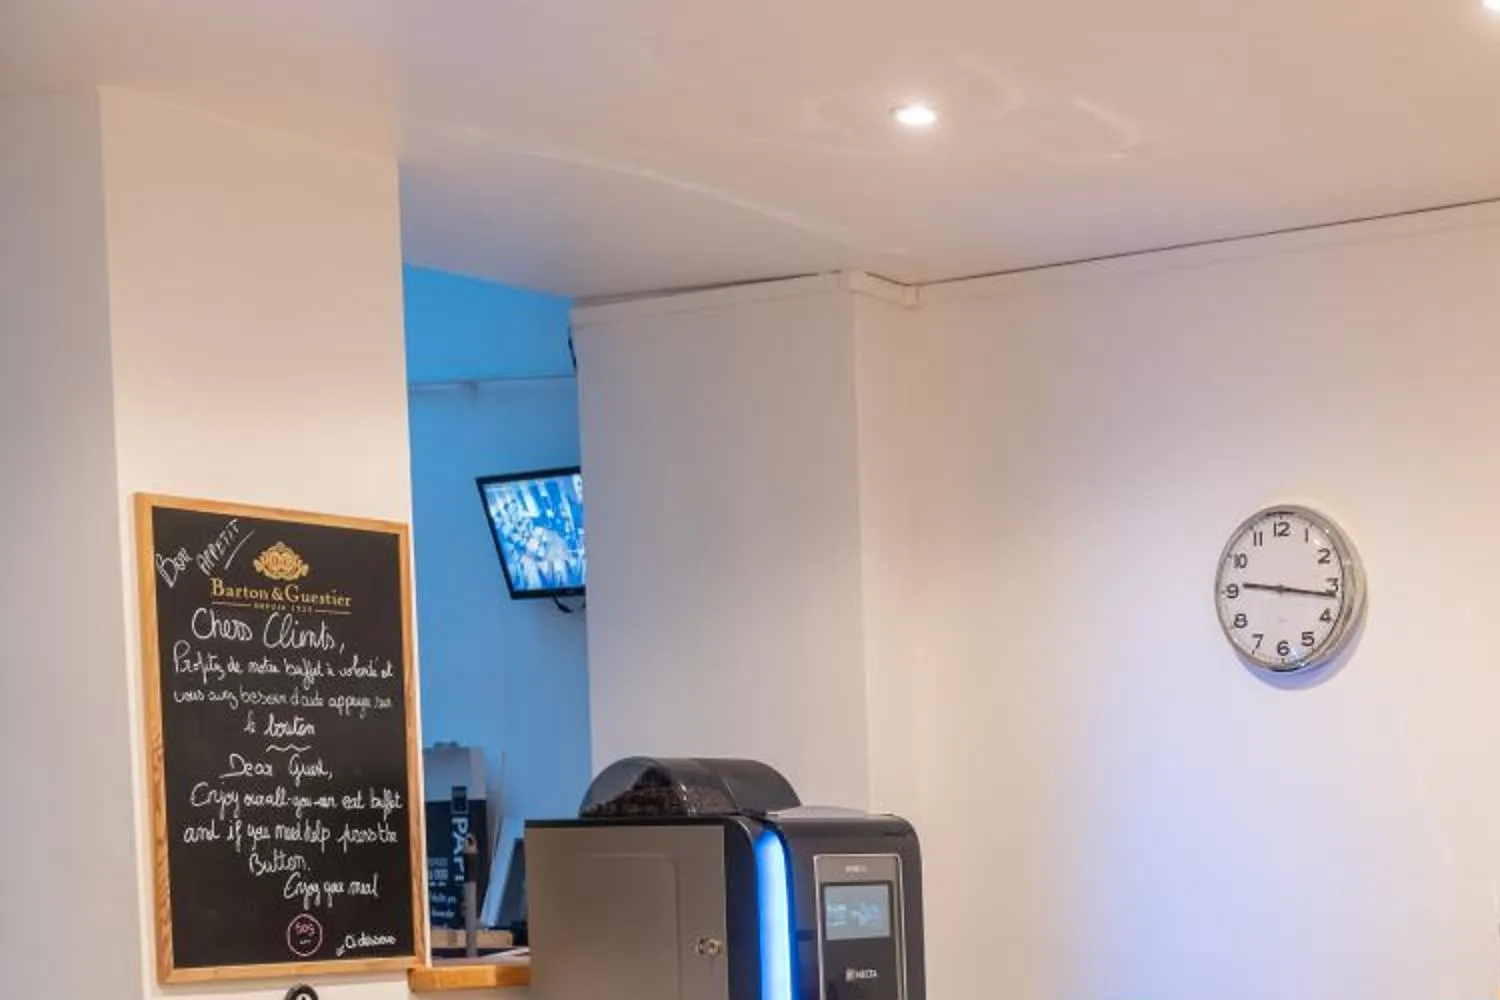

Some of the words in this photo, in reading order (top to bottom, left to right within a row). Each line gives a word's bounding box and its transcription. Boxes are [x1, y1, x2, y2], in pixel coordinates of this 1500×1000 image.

[1273, 521, 1291, 537] 12
[1253, 531, 1263, 547] 11
[1233, 553, 1248, 569] 10
[1317, 547, 1331, 564] 2
[1226, 583, 1240, 599] 9
[1233, 613, 1248, 629] 8
[1319, 607, 1332, 623] 4
[1252, 633, 1264, 649] 7
[1301, 631, 1315, 647] 5
[1277, 640, 1291, 656] 6
[183, 818, 220, 843] and
